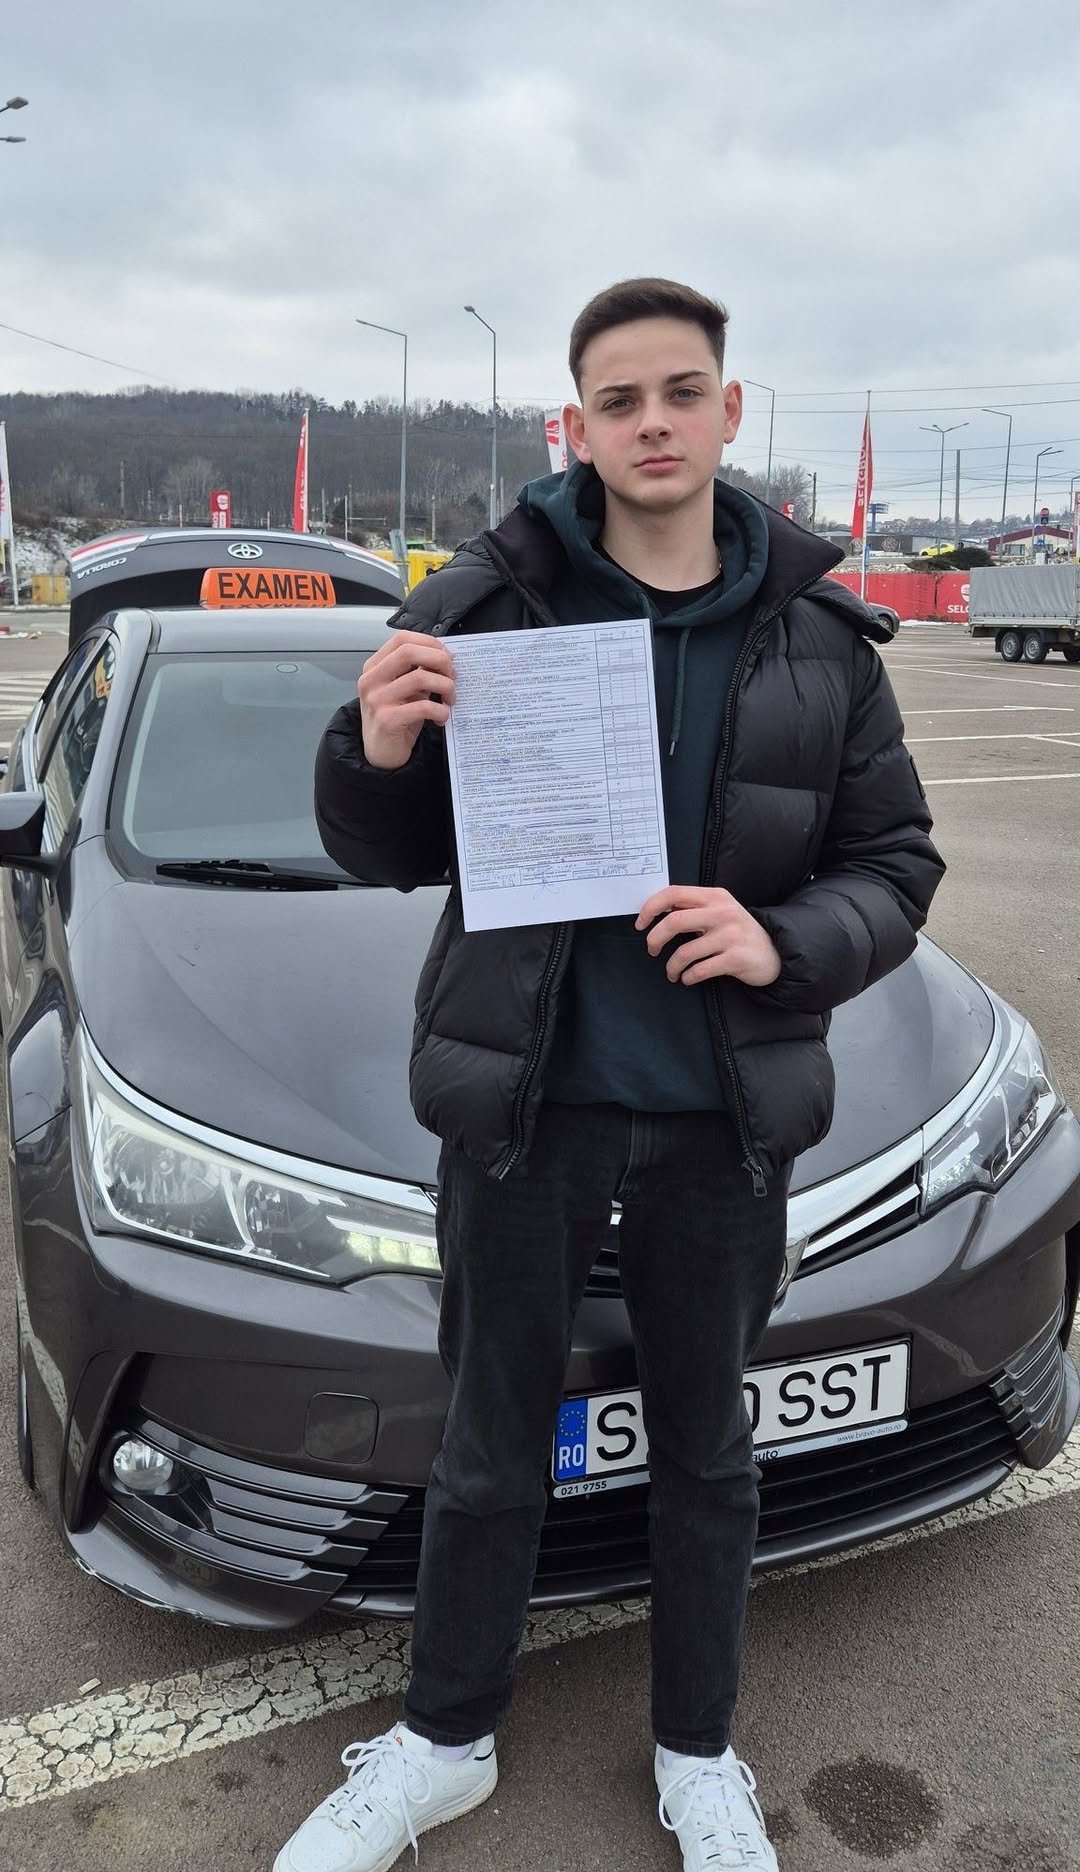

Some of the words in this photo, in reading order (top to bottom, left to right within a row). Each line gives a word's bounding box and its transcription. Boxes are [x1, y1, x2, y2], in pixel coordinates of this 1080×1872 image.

[77, 557, 127, 579] COROLLA
[217, 572, 329, 601] EXAMEN
[596, 1401, 638, 1462] S
[778, 1354, 891, 1428] SST
[837, 1424, 902, 1443] www.bravo-auto.ro
[558, 1443, 585, 1471] RO
[561, 1485, 579, 1496] 021
[582, 1480, 608, 1492] 9755
